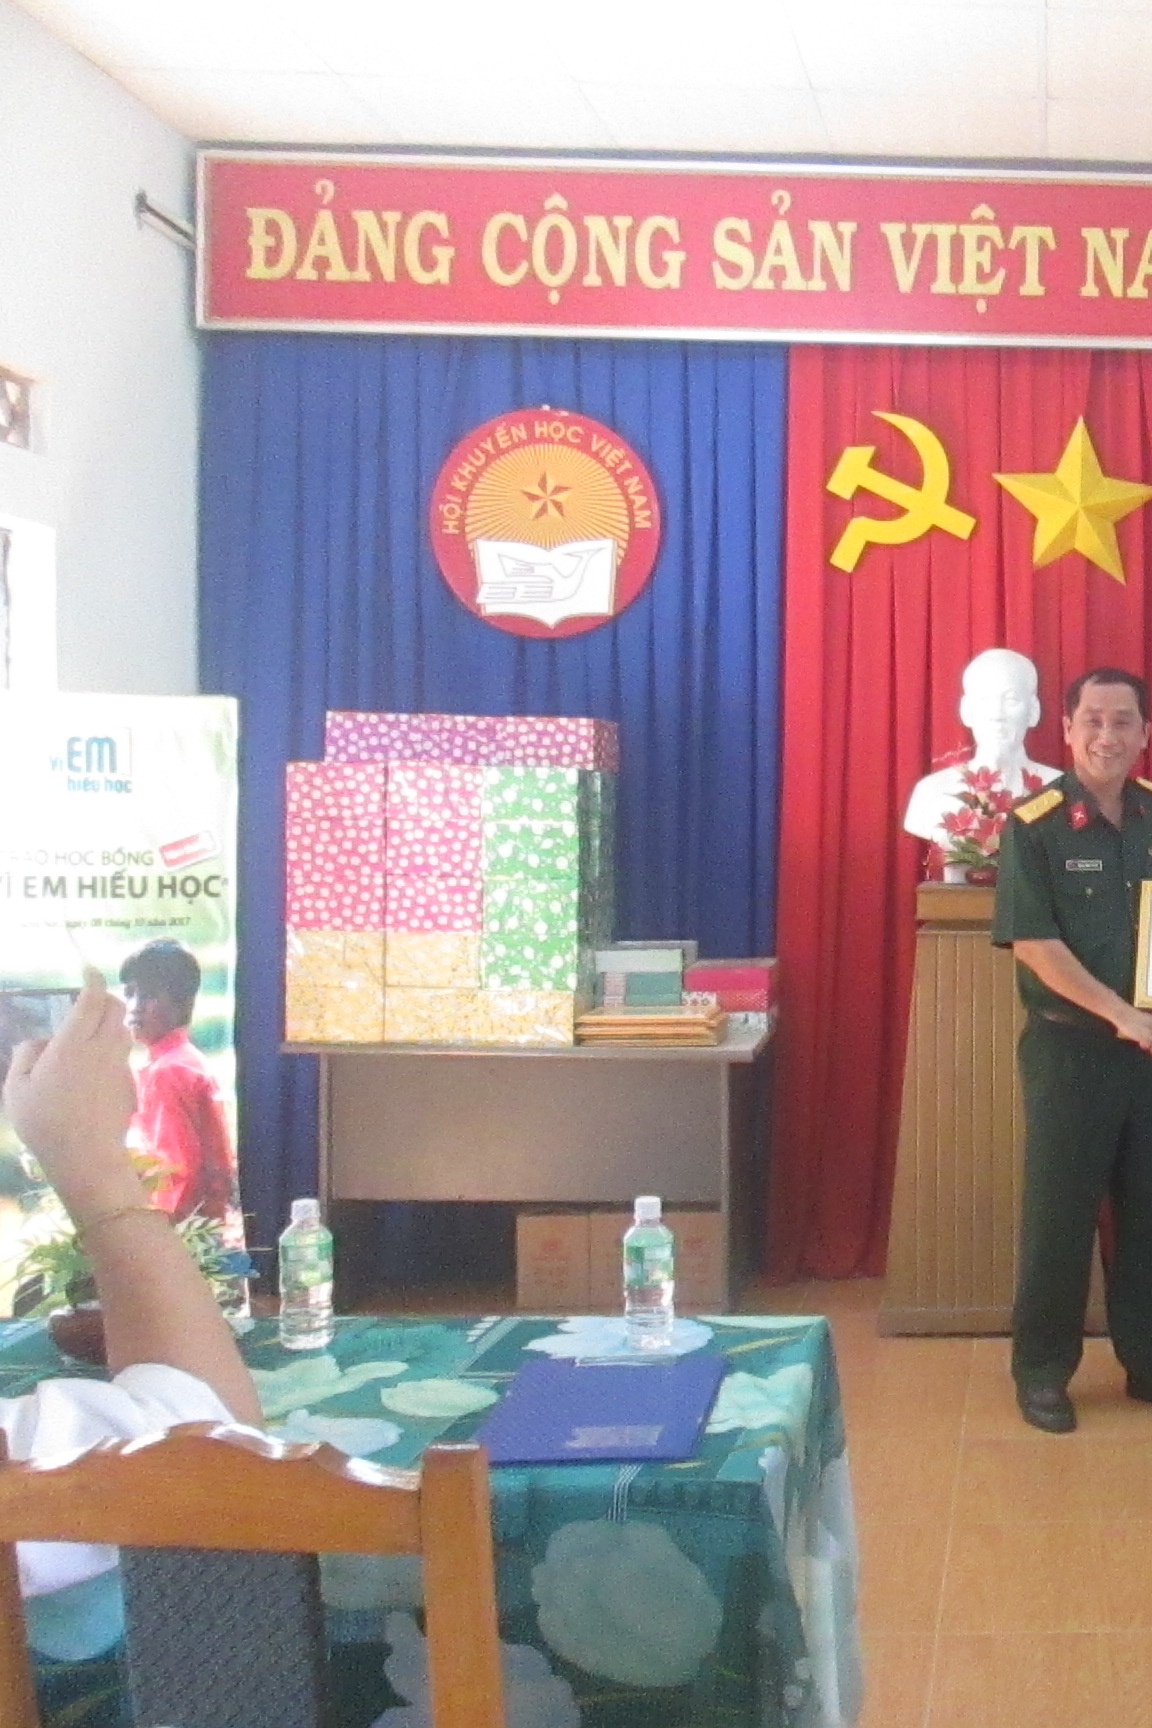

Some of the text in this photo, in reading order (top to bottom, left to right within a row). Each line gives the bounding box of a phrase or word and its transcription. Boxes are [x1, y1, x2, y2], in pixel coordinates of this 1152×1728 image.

[245, 180, 455, 285] ĐẢNG
[481, 193, 682, 304] CỘNG
[711, 189, 857, 292] SẢN
[880, 203, 1056, 314] VIỆT
[534, 421, 584, 442] HỌC
[591, 434, 633, 475] VIỆT
[624, 476, 652, 529] NAM
[23, 875, 67, 899] EM
[77, 868, 149, 899] HIẾU
